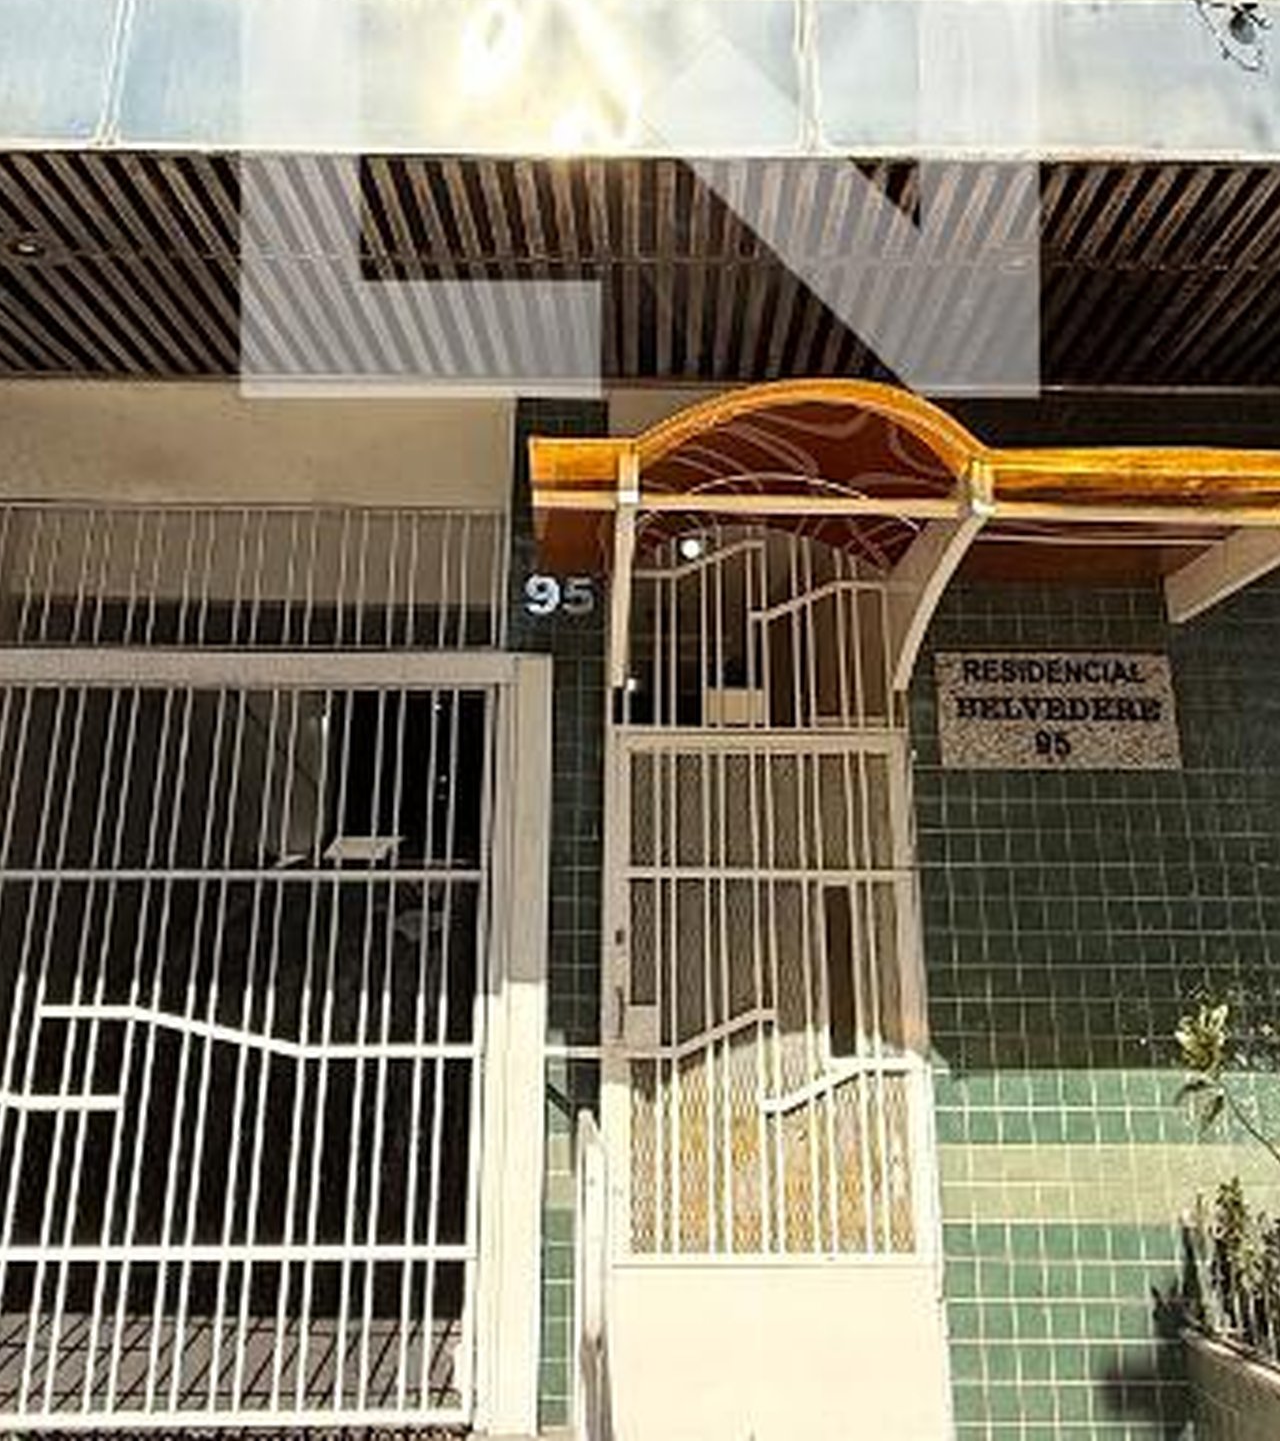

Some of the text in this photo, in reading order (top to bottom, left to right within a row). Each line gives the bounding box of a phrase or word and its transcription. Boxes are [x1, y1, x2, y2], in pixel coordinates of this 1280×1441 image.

[524, 575, 595, 614] 95
[963, 659, 1146, 683] RESIDENCIAL
[956, 697, 1161, 721] BELVEDERE
[1034, 730, 1071, 754] 95
